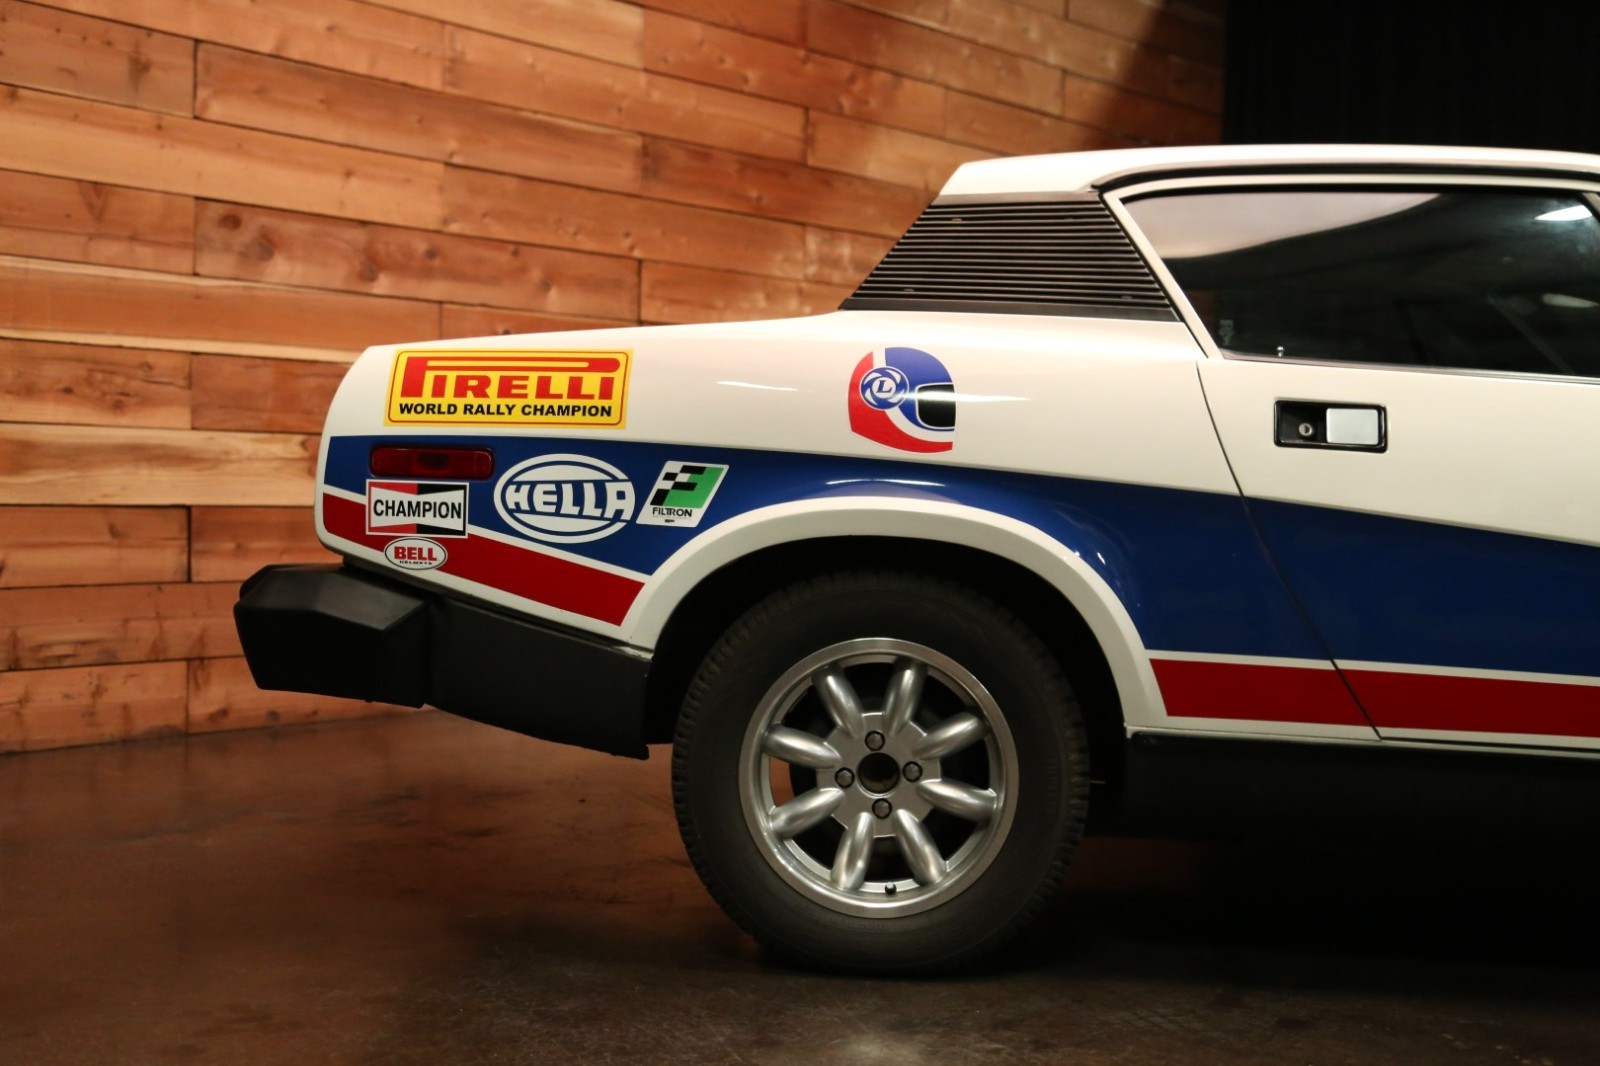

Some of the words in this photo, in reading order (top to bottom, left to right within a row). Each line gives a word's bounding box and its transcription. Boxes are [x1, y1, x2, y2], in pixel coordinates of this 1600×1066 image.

[401, 356, 621, 400] PIRELLI
[399, 403, 457, 415] WORLD
[463, 403, 516, 416] RALLY
[521, 404, 612, 417] CHAMPION
[373, 499, 462, 519] CHAMPION
[505, 481, 635, 521] HELLA
[652, 507, 693, 517] FILTRON
[394, 546, 437, 561] BELL
